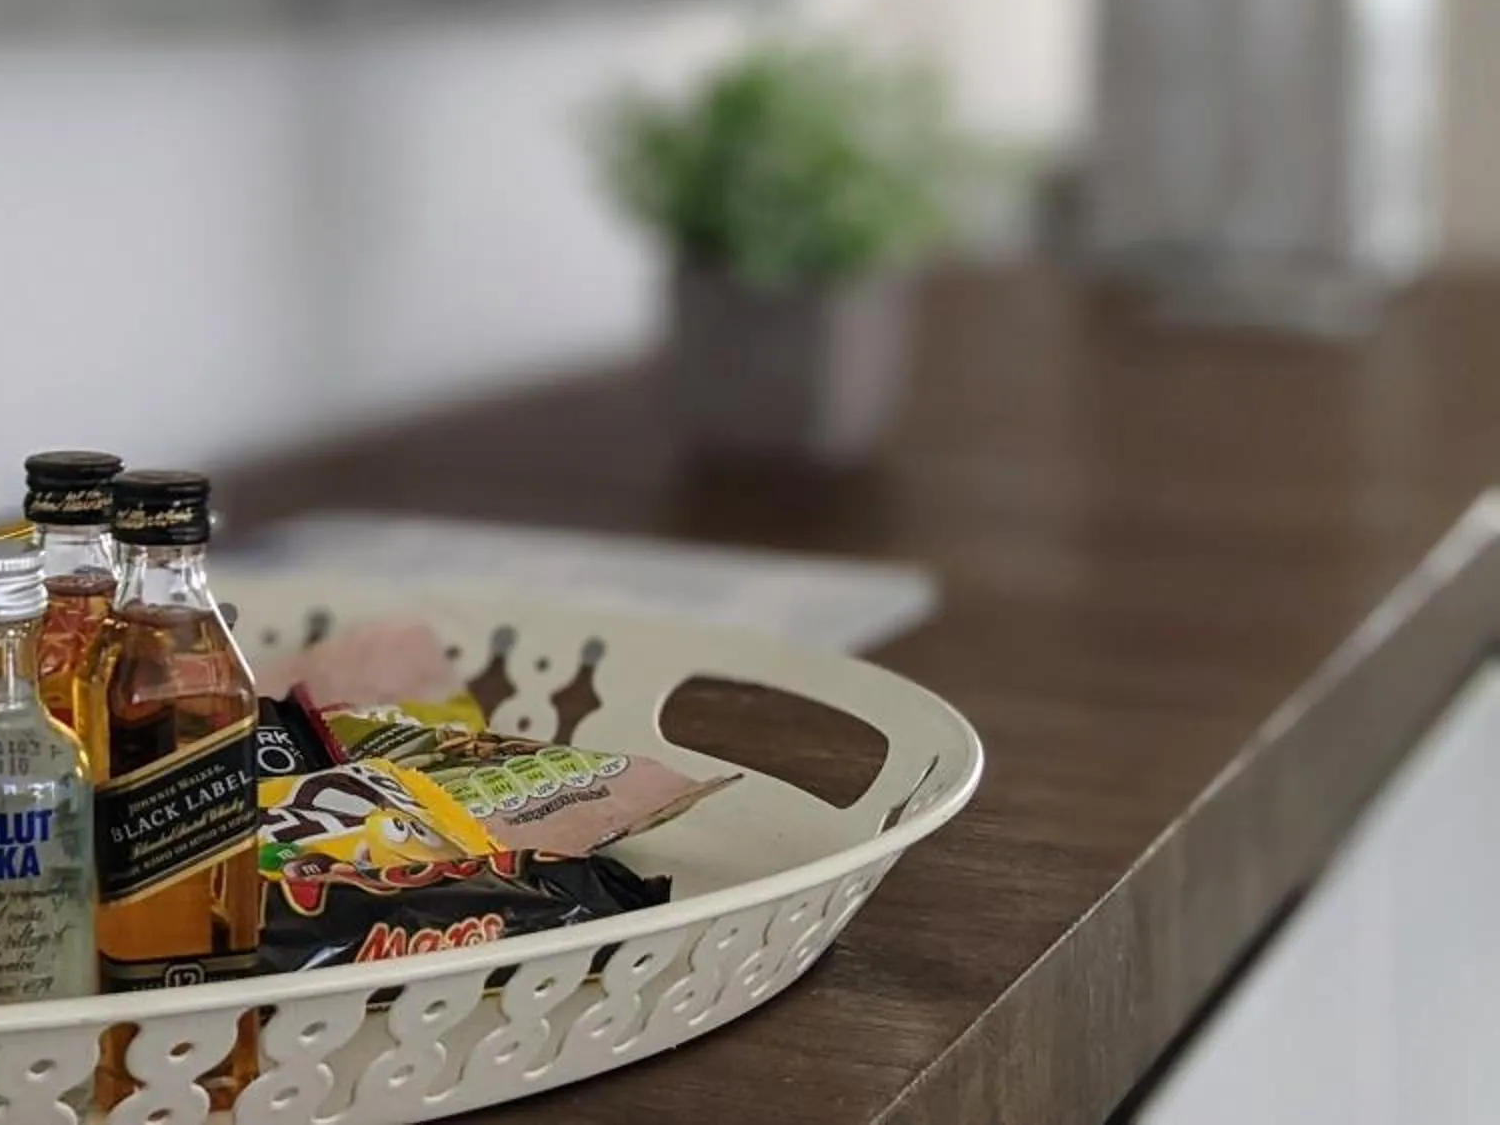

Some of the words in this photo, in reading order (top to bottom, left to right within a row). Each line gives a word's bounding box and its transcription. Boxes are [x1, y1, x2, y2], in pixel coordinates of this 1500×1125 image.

[110, 801, 181, 843] BLACK
[184, 770, 253, 811] LABEL
[302, 862, 321, 876] m
